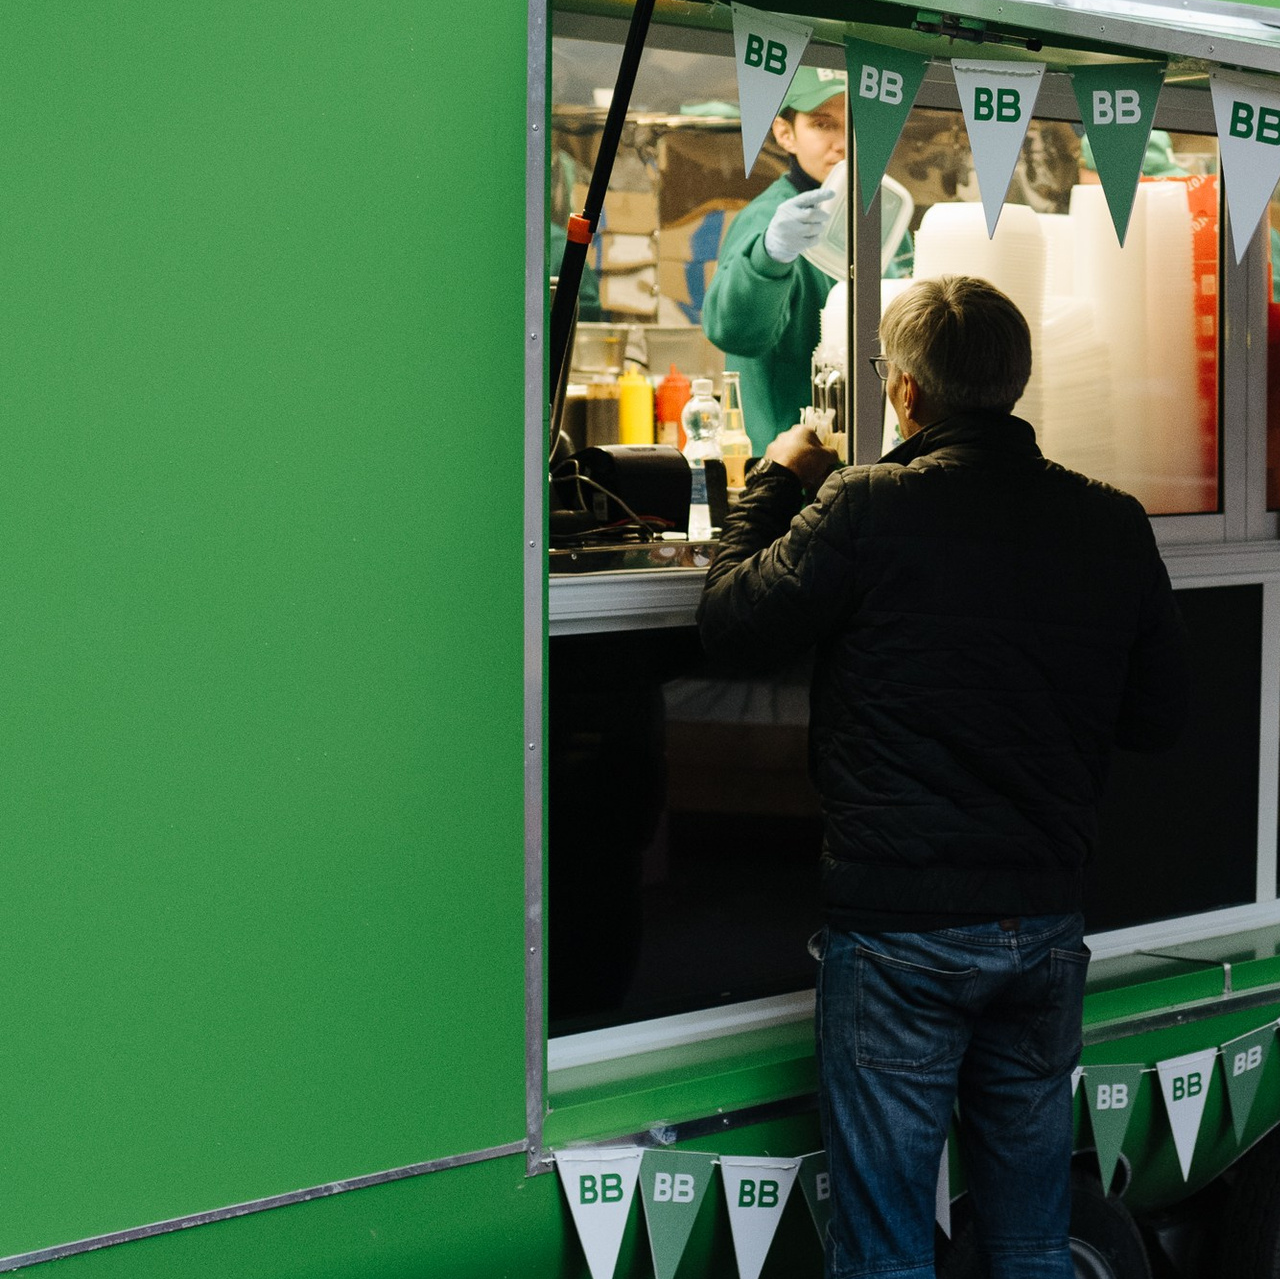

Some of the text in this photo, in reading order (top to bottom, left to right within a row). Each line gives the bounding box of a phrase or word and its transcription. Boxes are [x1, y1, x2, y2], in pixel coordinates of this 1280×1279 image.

[744, 33, 788, 75] ВВ
[859, 64, 904, 105] ВВ
[974, 87, 1021, 123] ВВ
[1092, 89, 1142, 125] ВВ
[1233, 1045, 1262, 1077] ВВ
[1096, 1083, 1129, 1110] ВВ
[1172, 1072, 1202, 1101] ВВ
[579, 1173, 624, 1205] ВВ
[653, 1172, 695, 1203] ВВ
[738, 1179, 779, 1209] ВВ
